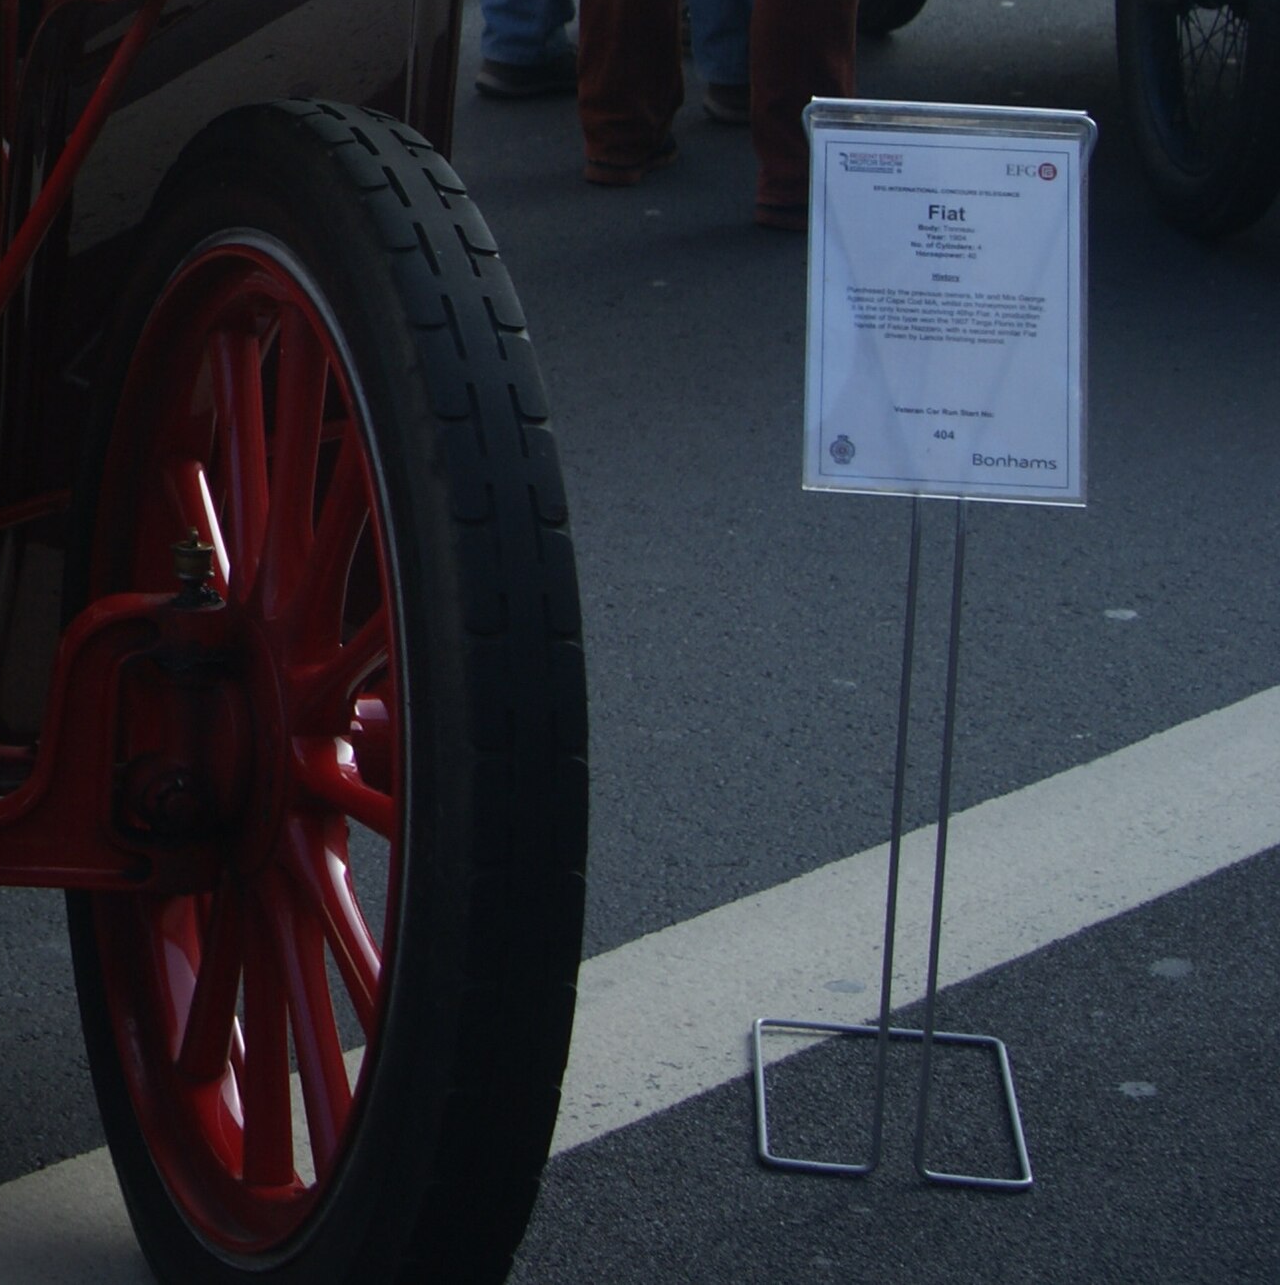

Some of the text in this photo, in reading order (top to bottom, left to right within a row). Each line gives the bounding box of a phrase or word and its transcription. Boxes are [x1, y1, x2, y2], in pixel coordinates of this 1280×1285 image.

[1006, 164, 1037, 177] EFG
[928, 204, 966, 222] Fiat
[893, 405, 924, 414] Veteran
[926, 407, 940, 415] Car
[942, 408, 958, 416] Run
[960, 409, 980, 417] Start
[933, 429, 955, 440] 404
[972, 452, 1058, 470] Bonhams
